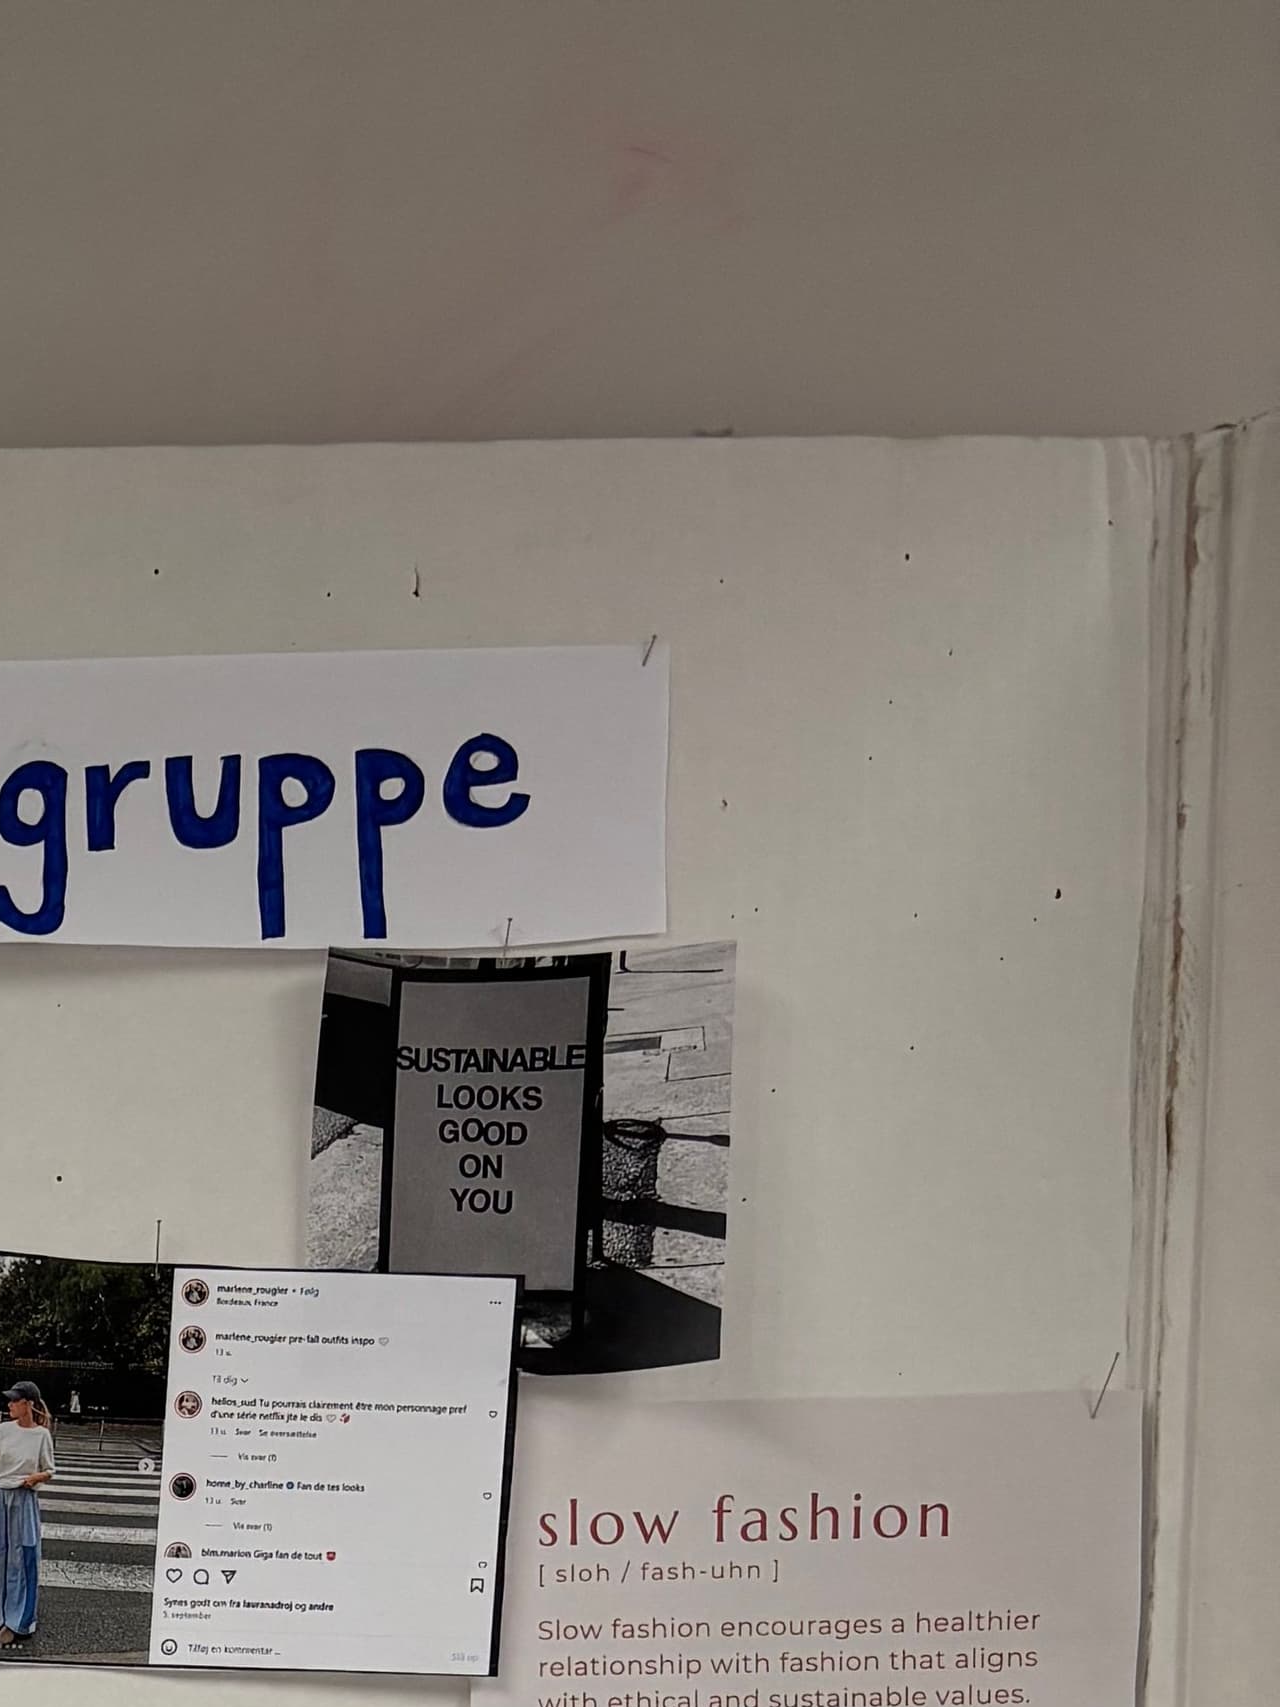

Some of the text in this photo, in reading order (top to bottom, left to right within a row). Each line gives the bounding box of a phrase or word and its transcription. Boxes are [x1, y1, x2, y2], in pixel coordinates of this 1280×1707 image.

[396, 1045, 587, 1073] SUSTAINABLE
[437, 1084, 543, 1111] LOOKS
[439, 1118, 528, 1146] GOOD
[459, 1154, 503, 1179] ON
[450, 1188, 514, 1215] YOU
[539, 1492, 949, 1548] slow fashion
[556, 1560, 761, 1583] sloh fash-uhn
[538, 1609, 1041, 1641] Slow fashion encourages a healthier
[539, 1647, 1039, 1680] relationship with fashion that aligns
[935, 1683, 1031, 1707] values.
